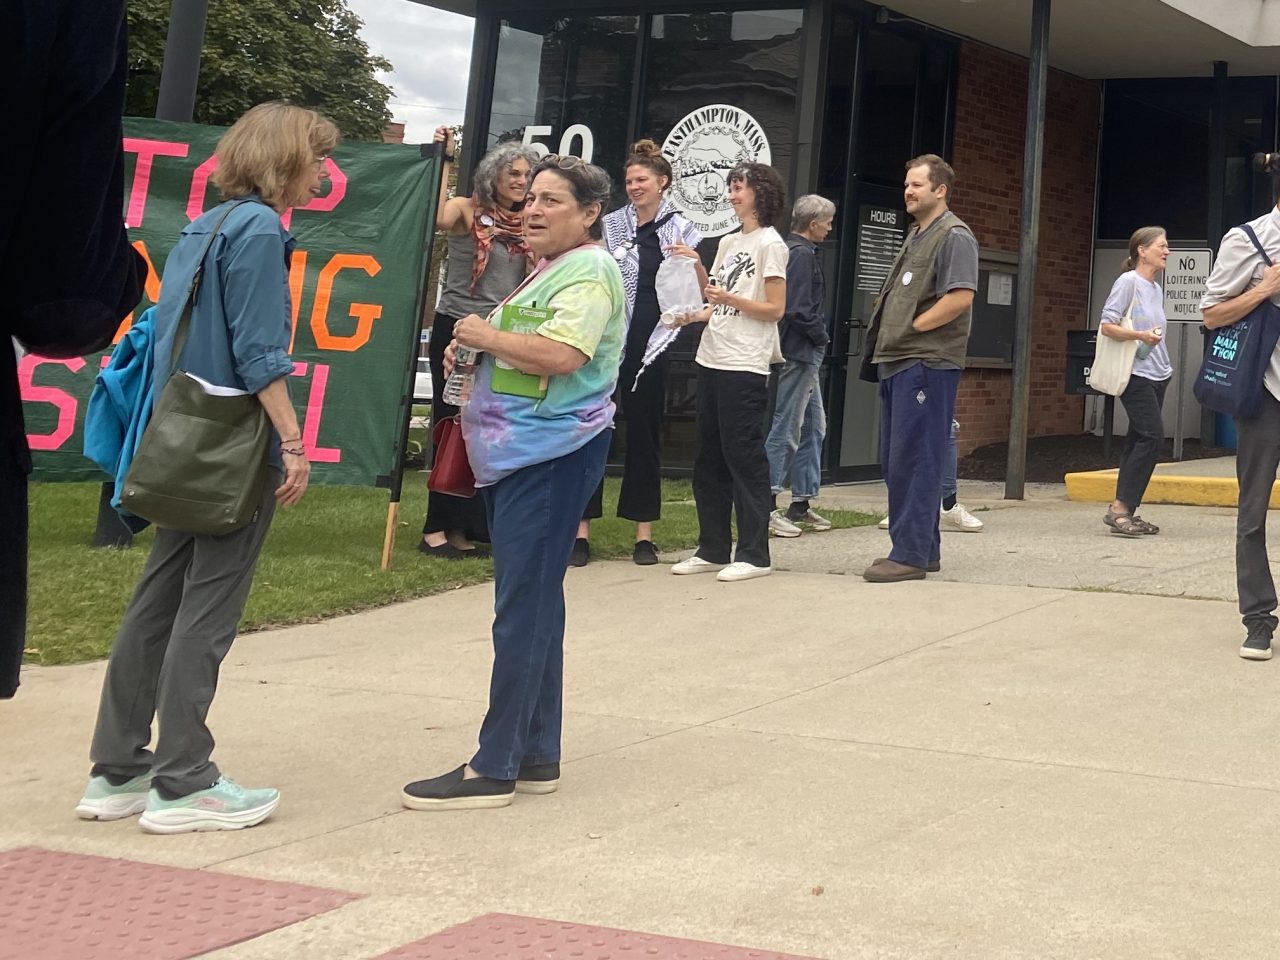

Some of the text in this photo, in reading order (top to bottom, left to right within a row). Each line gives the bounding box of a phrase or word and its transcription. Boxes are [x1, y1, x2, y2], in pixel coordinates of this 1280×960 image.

[521, 124, 594, 164] 50
[742, 119, 766, 157] MASS.
[870, 209, 897, 225] HOURS
[711, 219, 730, 232] JUNE
[1179, 257, 1196, 271] NO
[1166, 275, 1207, 285] LOITERING
[1166, 290, 1187, 300] POLICE
[1173, 303, 1197, 314] NOTICE
